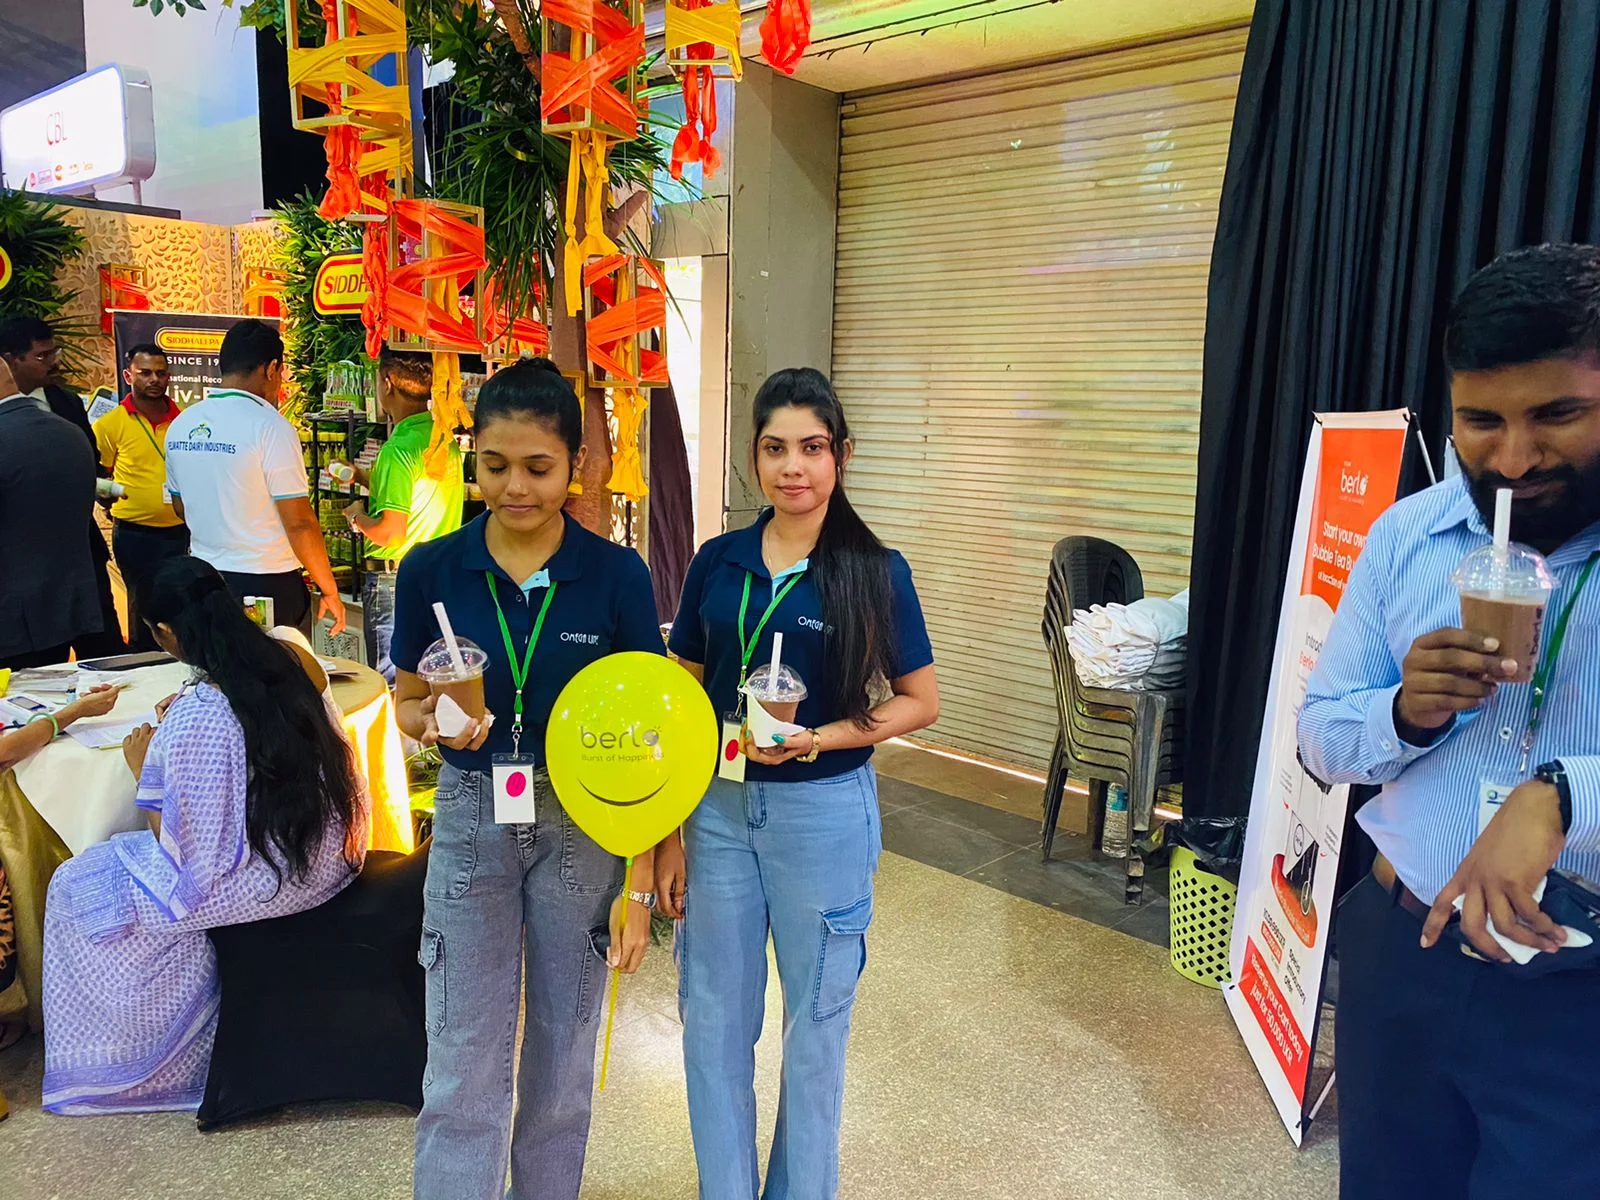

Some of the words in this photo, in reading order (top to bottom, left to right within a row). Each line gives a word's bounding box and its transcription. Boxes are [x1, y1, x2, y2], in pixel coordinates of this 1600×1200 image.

[47, 109, 68, 145] CBL
[323, 273, 367, 295] SIDDH
[166, 356, 203, 366] SINCE
[189, 442, 203, 451] DAIRY
[204, 442, 236, 454] INDUSTRIES
[1340, 468, 1369, 496] berlo
[1323, 520, 1338, 540] Start
[1337, 527, 1354, 549] your
[1312, 543, 1334, 564] Bubble
[1334, 550, 1346, 569] Tea
[580, 725, 661, 749] berlo
[581, 753, 603, 761] Burst
